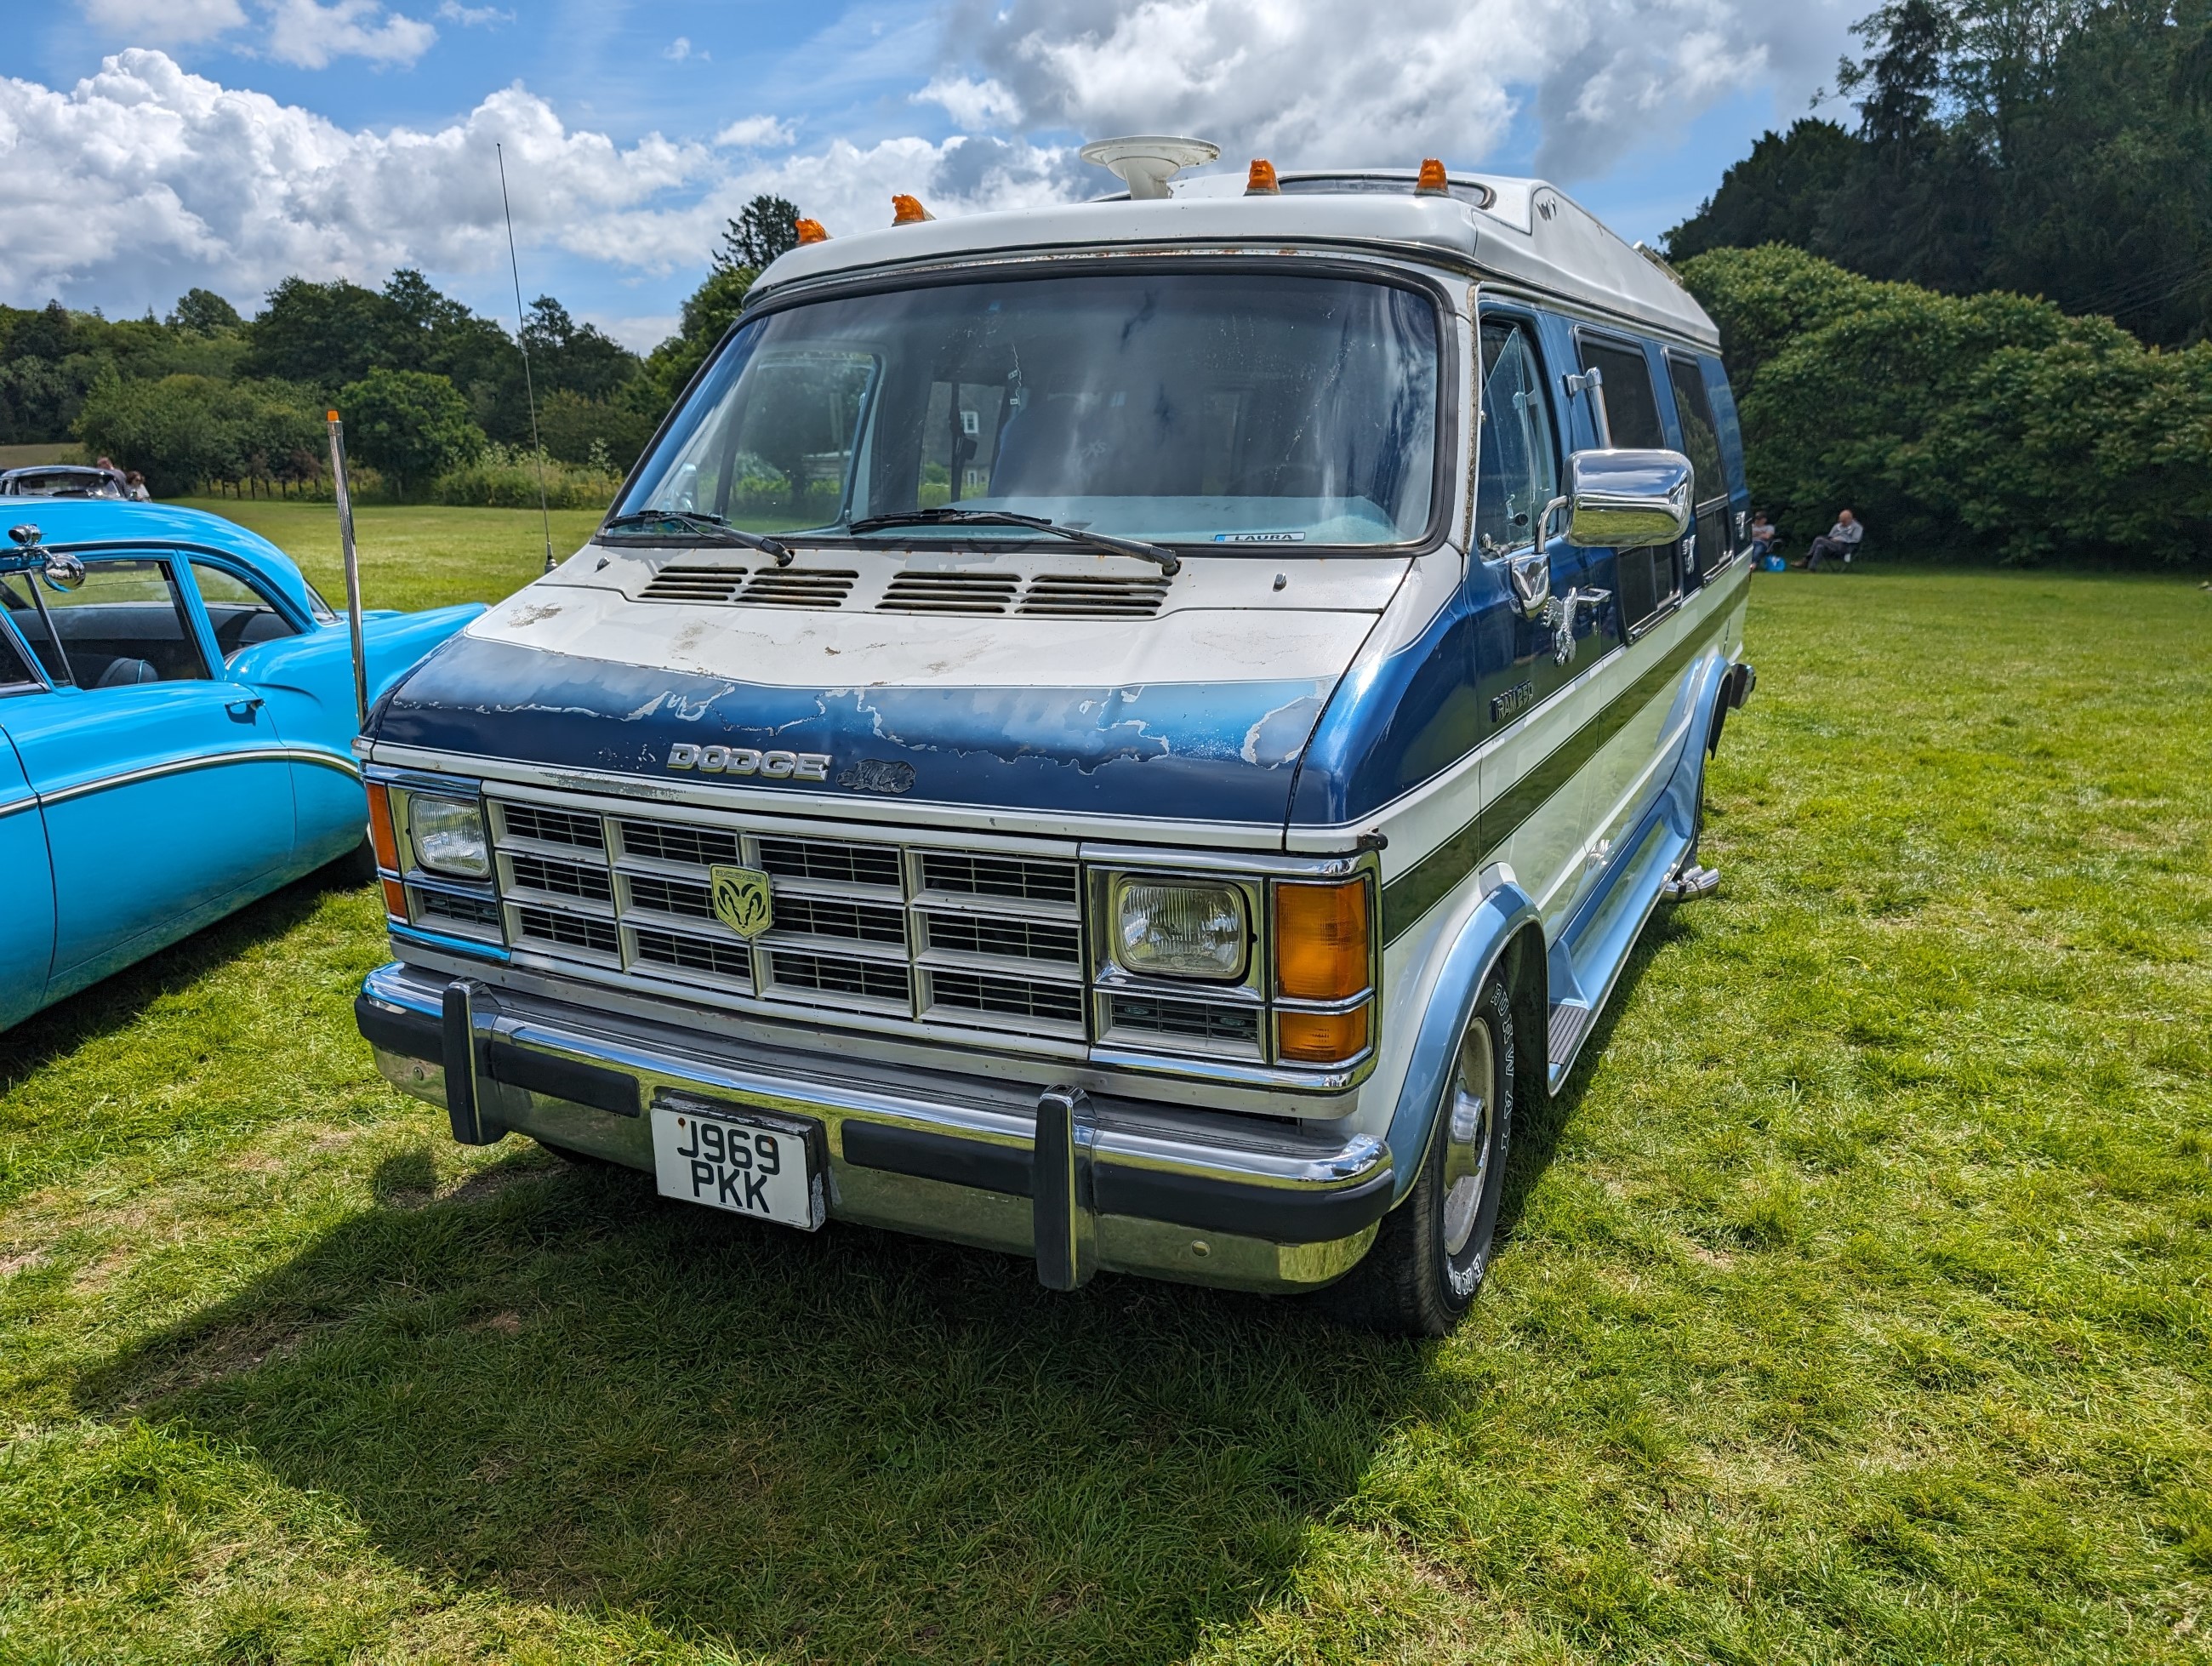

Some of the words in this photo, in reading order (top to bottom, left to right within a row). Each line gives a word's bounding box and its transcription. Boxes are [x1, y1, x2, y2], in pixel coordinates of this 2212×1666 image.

[667, 743, 833, 781] DODGE
[677, 1121, 780, 1175] J969
[691, 1159, 770, 1213] PKK
